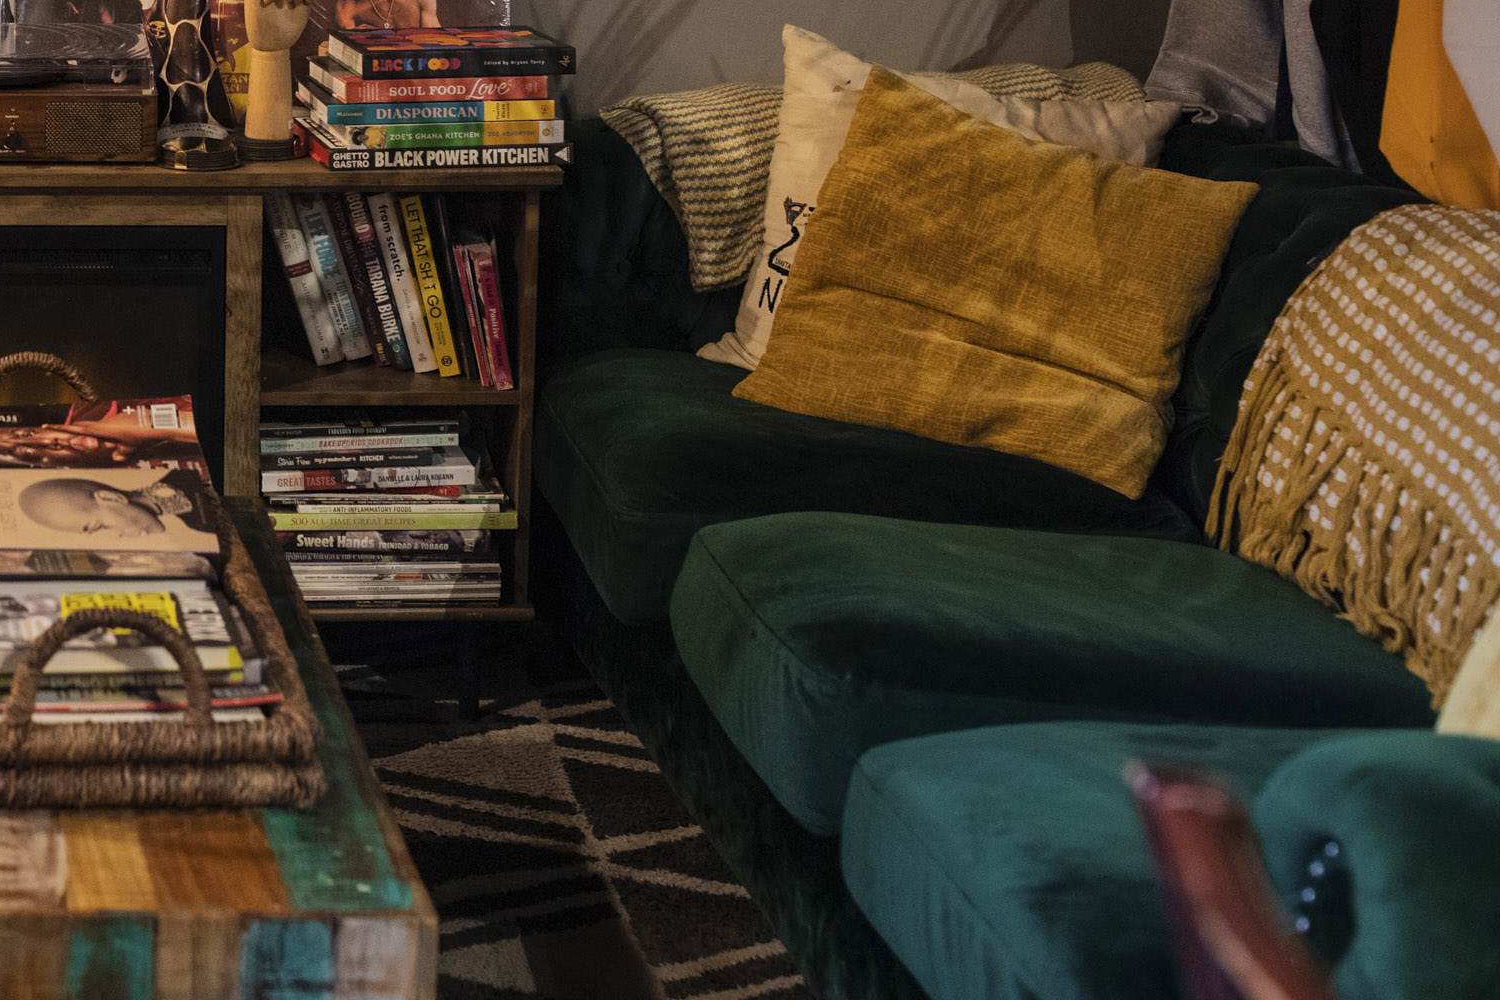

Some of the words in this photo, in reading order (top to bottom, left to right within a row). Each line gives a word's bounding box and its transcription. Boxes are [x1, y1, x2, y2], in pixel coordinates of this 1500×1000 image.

[372, 57, 413, 72] BLACK
[418, 57, 460, 71] FOOD
[389, 86, 427, 97] SOUL
[429, 85, 466, 96] FOOD
[466, 78, 510, 99] Love
[376, 106, 478, 120] DIASPORICAN
[415, 132, 443, 140] GHANA
[445, 131, 480, 139] KITCHEN
[333, 152, 369, 161] GHETTO
[333, 160, 369, 168] GASTRO
[375, 151, 423, 168] BLACK
[426, 149, 478, 166] POWER
[482, 147, 549, 164] KITCHEN
[378, 204, 391, 232] from
[386, 235, 405, 281] scratch.
[405, 202, 418, 222] LET
[412, 224, 427, 258] THAT
[427, 295, 442, 318] GO
[365, 257, 388, 303] TARANA
[377, 304, 400, 342] BURKE
[488, 307, 499, 339] Positive
[318, 440, 335, 448] BAKE
[277, 477, 303, 487] GREAT
[306, 476, 336, 486] TASTES
[291, 517, 308, 526] 500
[310, 517, 350, 526] ALL-TIME
[353, 517, 382, 525] GREAT
[384, 516, 416, 525] RECIPES
[297, 534, 334, 548] Sweet
[337, 534, 374, 548] Hands
[378, 542, 412, 551] TRINIDAD
[421, 542, 449, 551] TOBAGO
